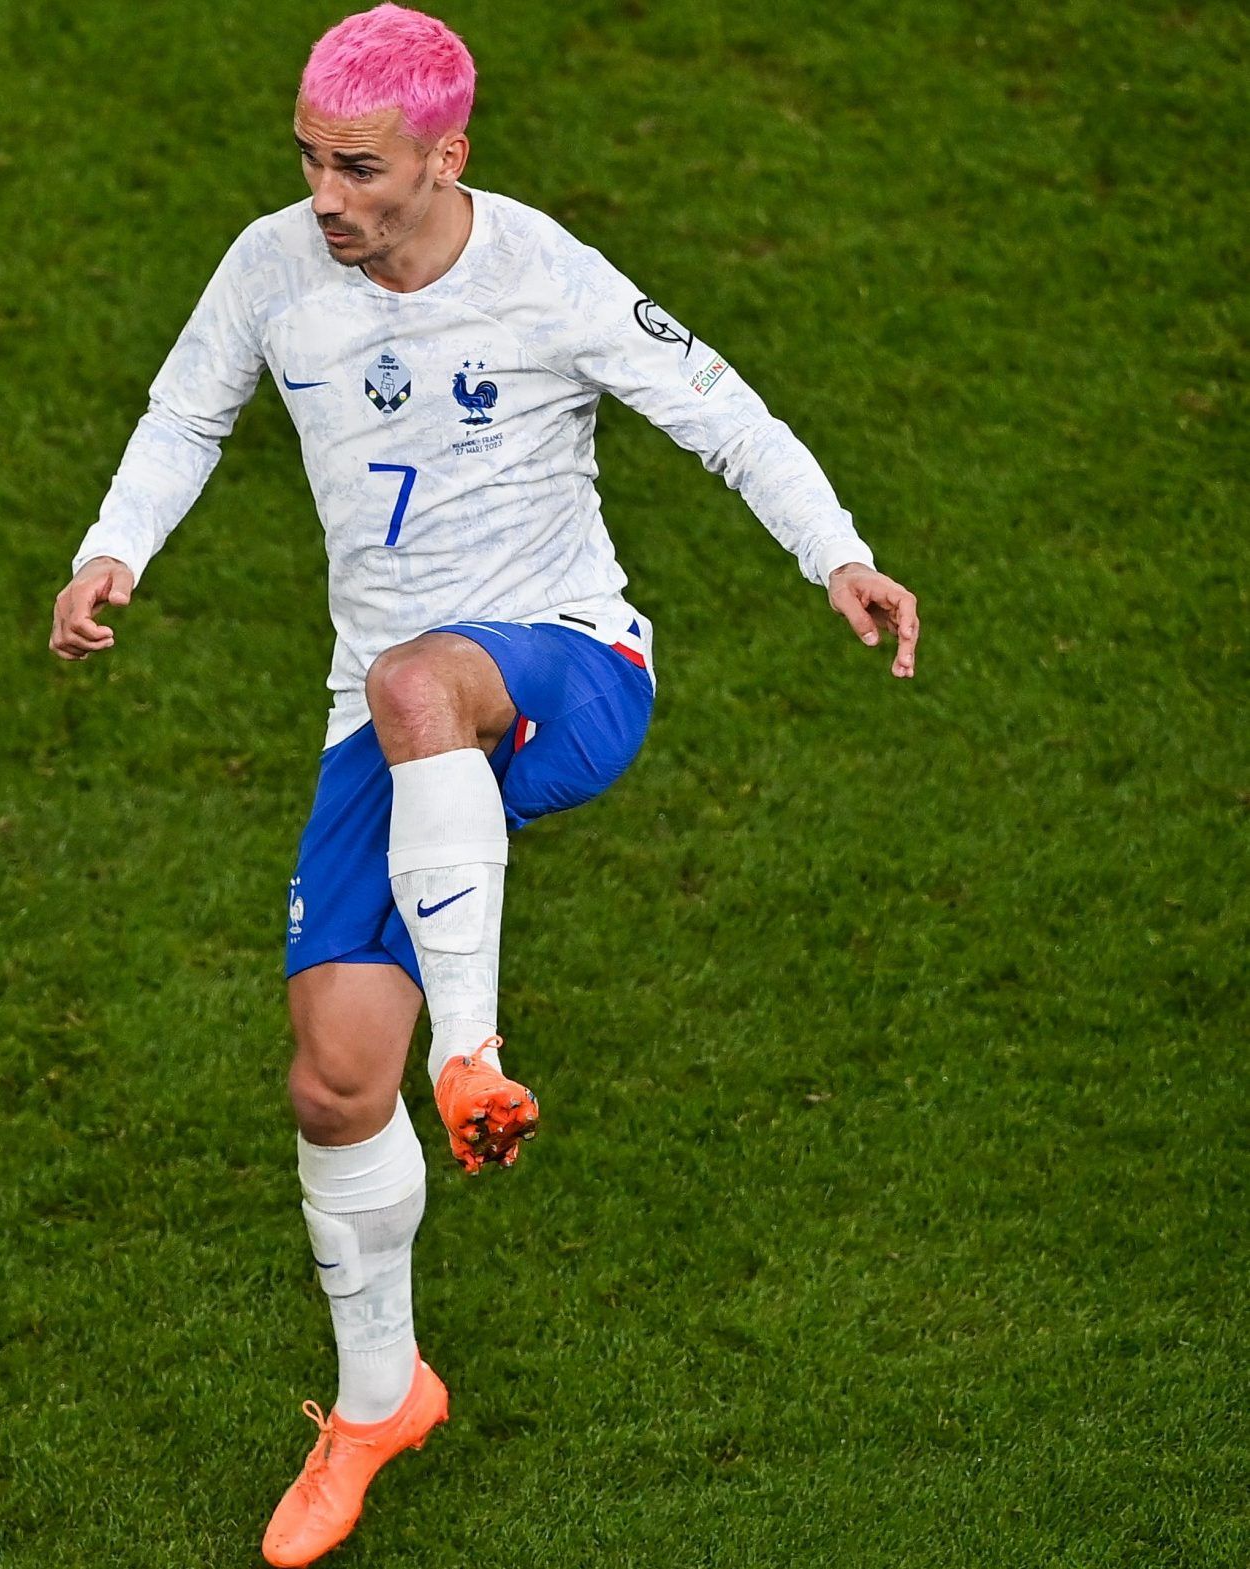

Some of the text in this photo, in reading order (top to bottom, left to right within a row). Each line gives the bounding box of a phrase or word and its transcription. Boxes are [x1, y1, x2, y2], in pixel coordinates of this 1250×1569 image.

[455, 440, 503, 456] 27 MARS 2023
[367, 462, 418, 547] 7
